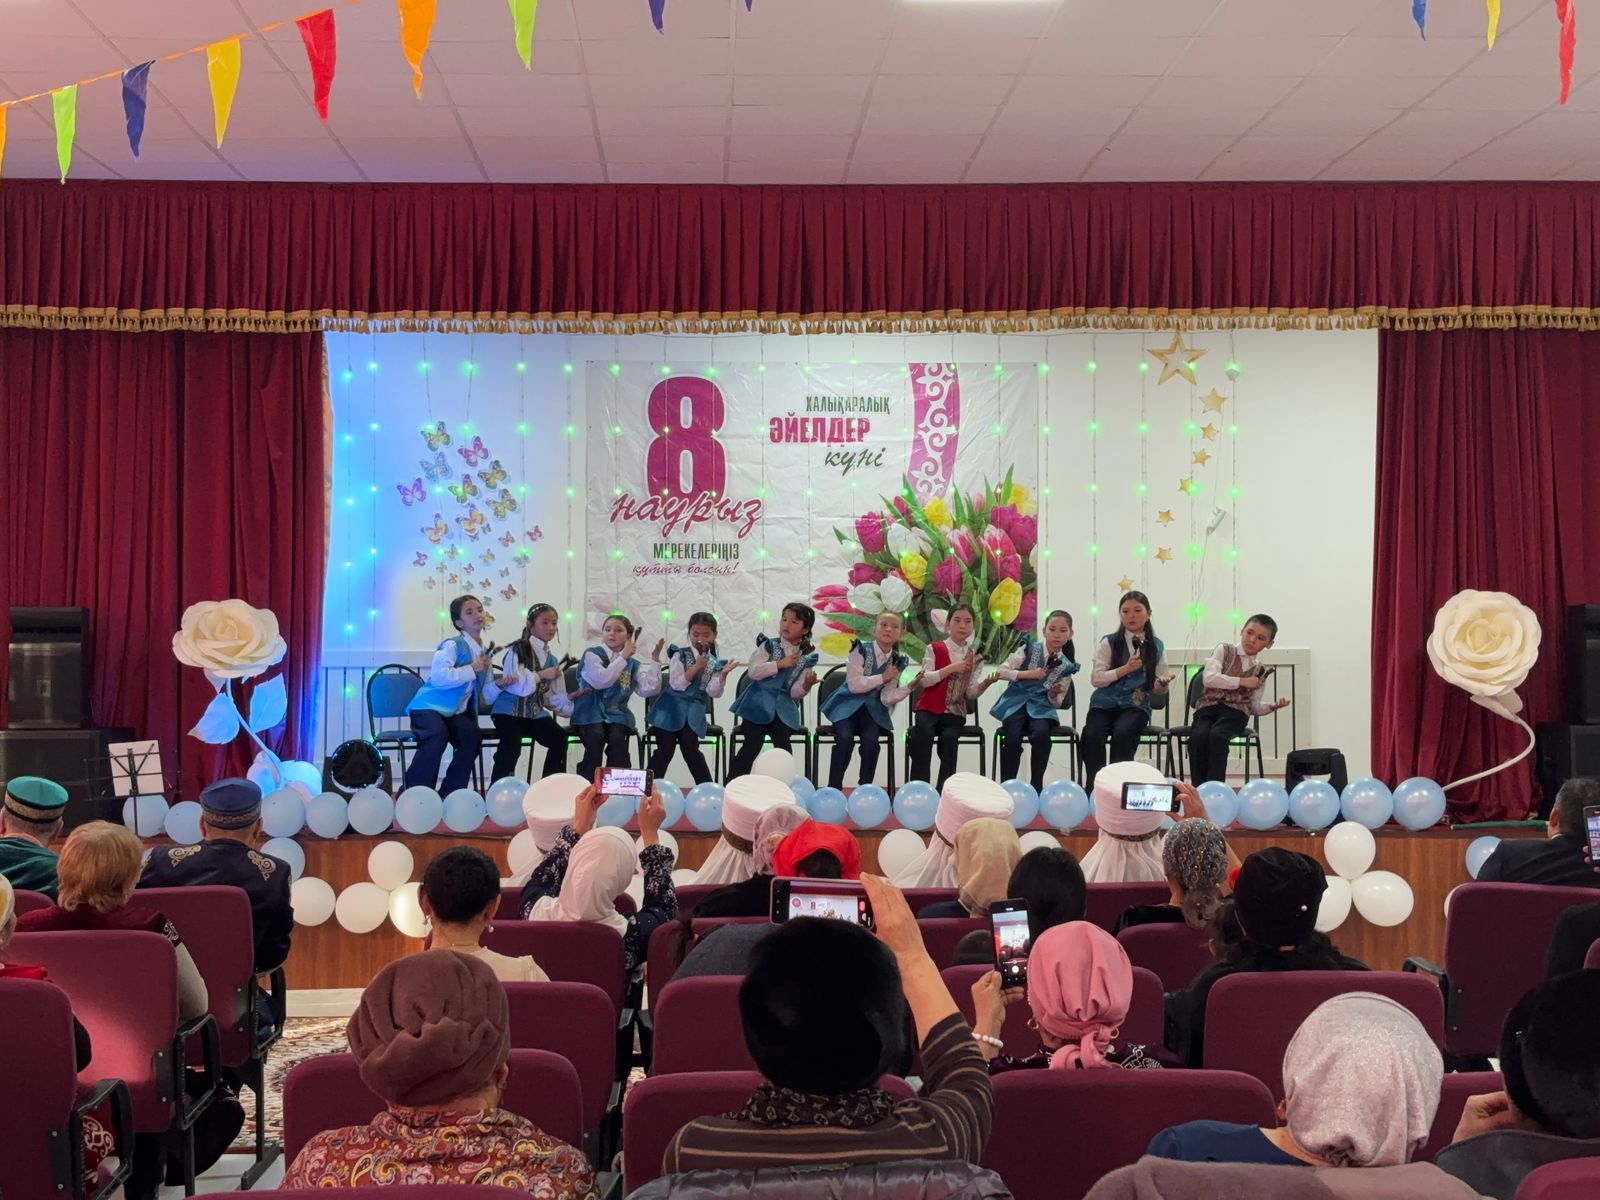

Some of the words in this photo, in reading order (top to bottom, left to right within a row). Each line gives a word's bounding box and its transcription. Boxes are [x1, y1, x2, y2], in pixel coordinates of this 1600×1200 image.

[806, 396, 890, 414] ХАЛЫҚАРАЛЫҚ
[647, 375, 727, 504] 8
[769, 411, 871, 447] ӘЙЕЛДЕР
[609, 491, 763, 539] наурыз
[653, 542, 740, 562] МЕРЕКЕЛЕРІҢІЗ
